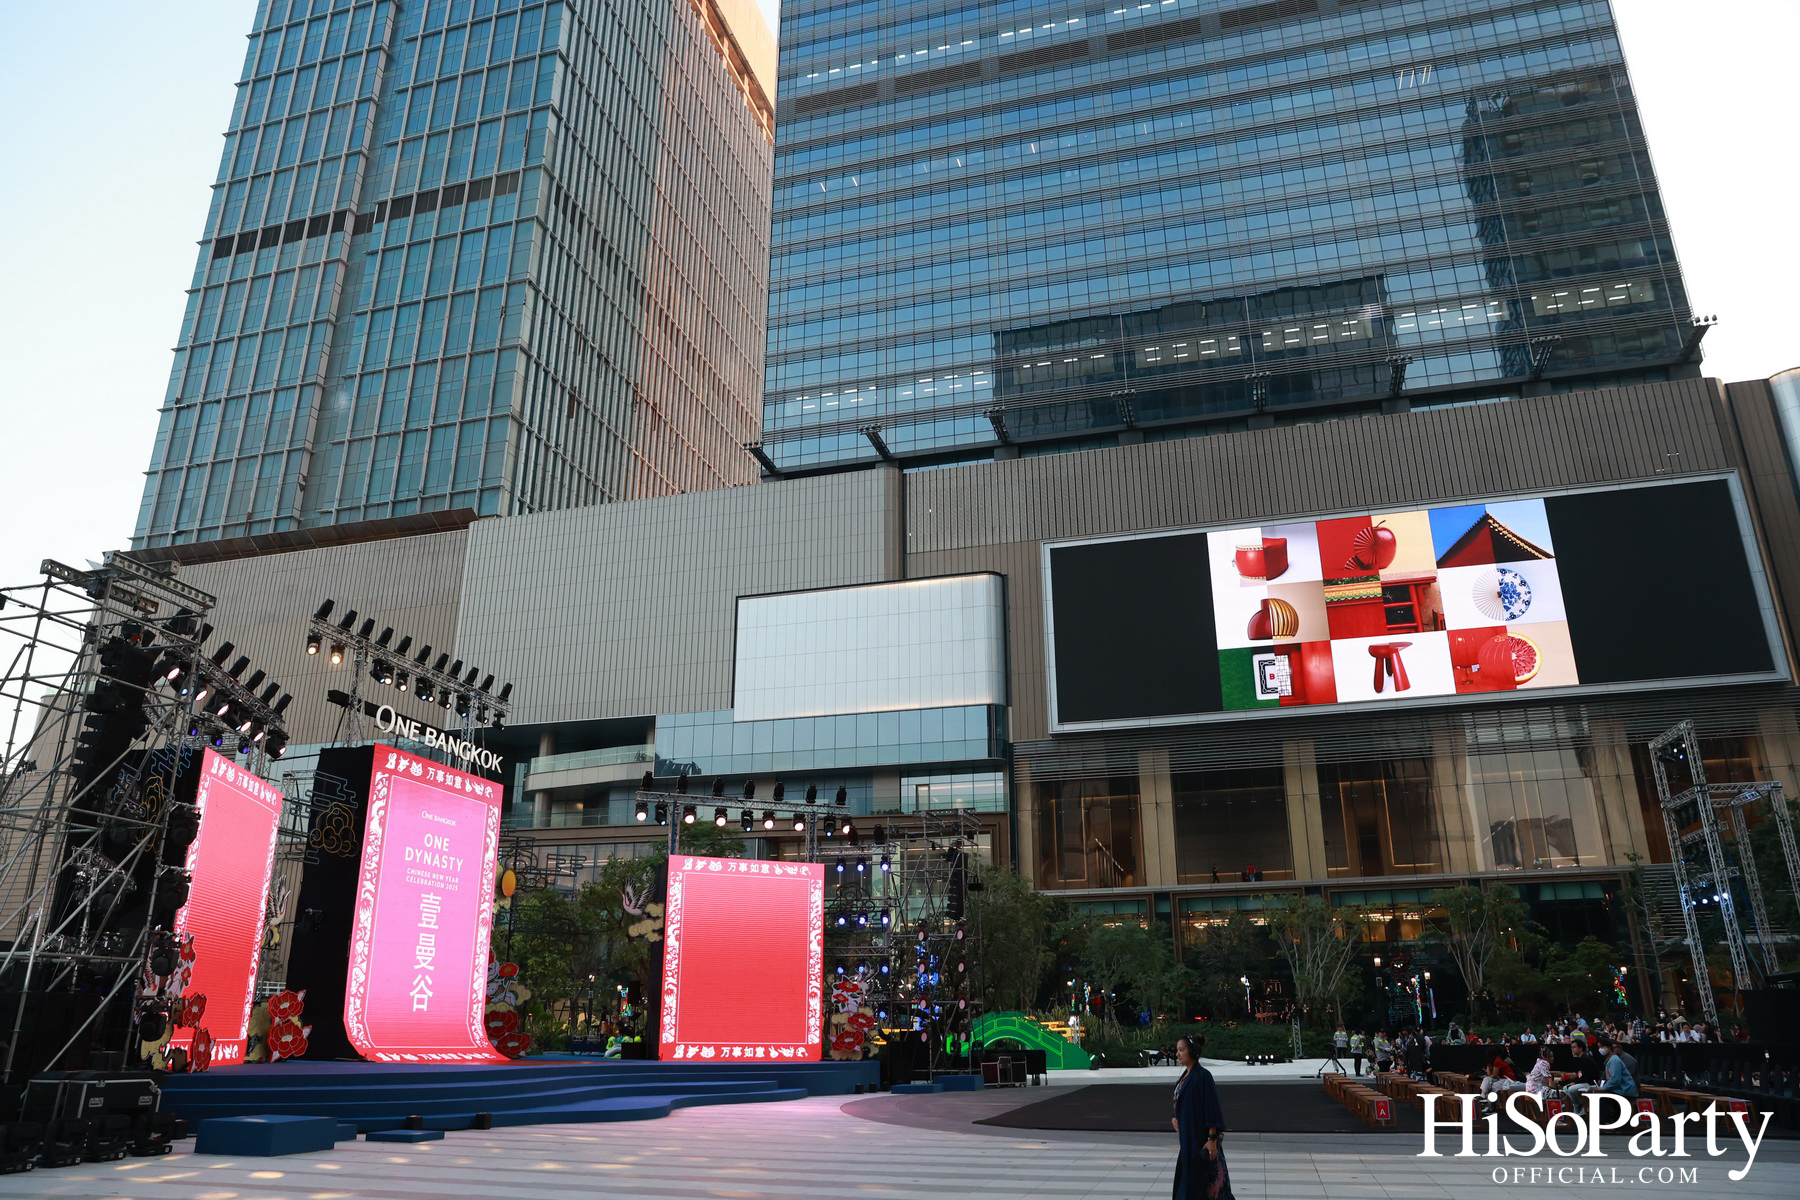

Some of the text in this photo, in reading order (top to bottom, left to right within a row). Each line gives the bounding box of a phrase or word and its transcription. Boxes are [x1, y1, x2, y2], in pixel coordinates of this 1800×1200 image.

[424, 727, 504, 774] BANGKOK
[426, 767, 462, 789] 万事如意
[424, 833, 450, 852] ONE
[405, 846, 464, 872] DYNASTY
[406, 867, 431, 878] CHINESE
[445, 875, 459, 883] YEAR
[727, 862, 770, 874] 万事如意
[405, 875, 458, 891] CELEBRATION 2025
[409, 892, 442, 1012] 壹曼谷
[720, 1046, 765, 1058] 万事如意
[1379, 1108, 1386, 1116] A
